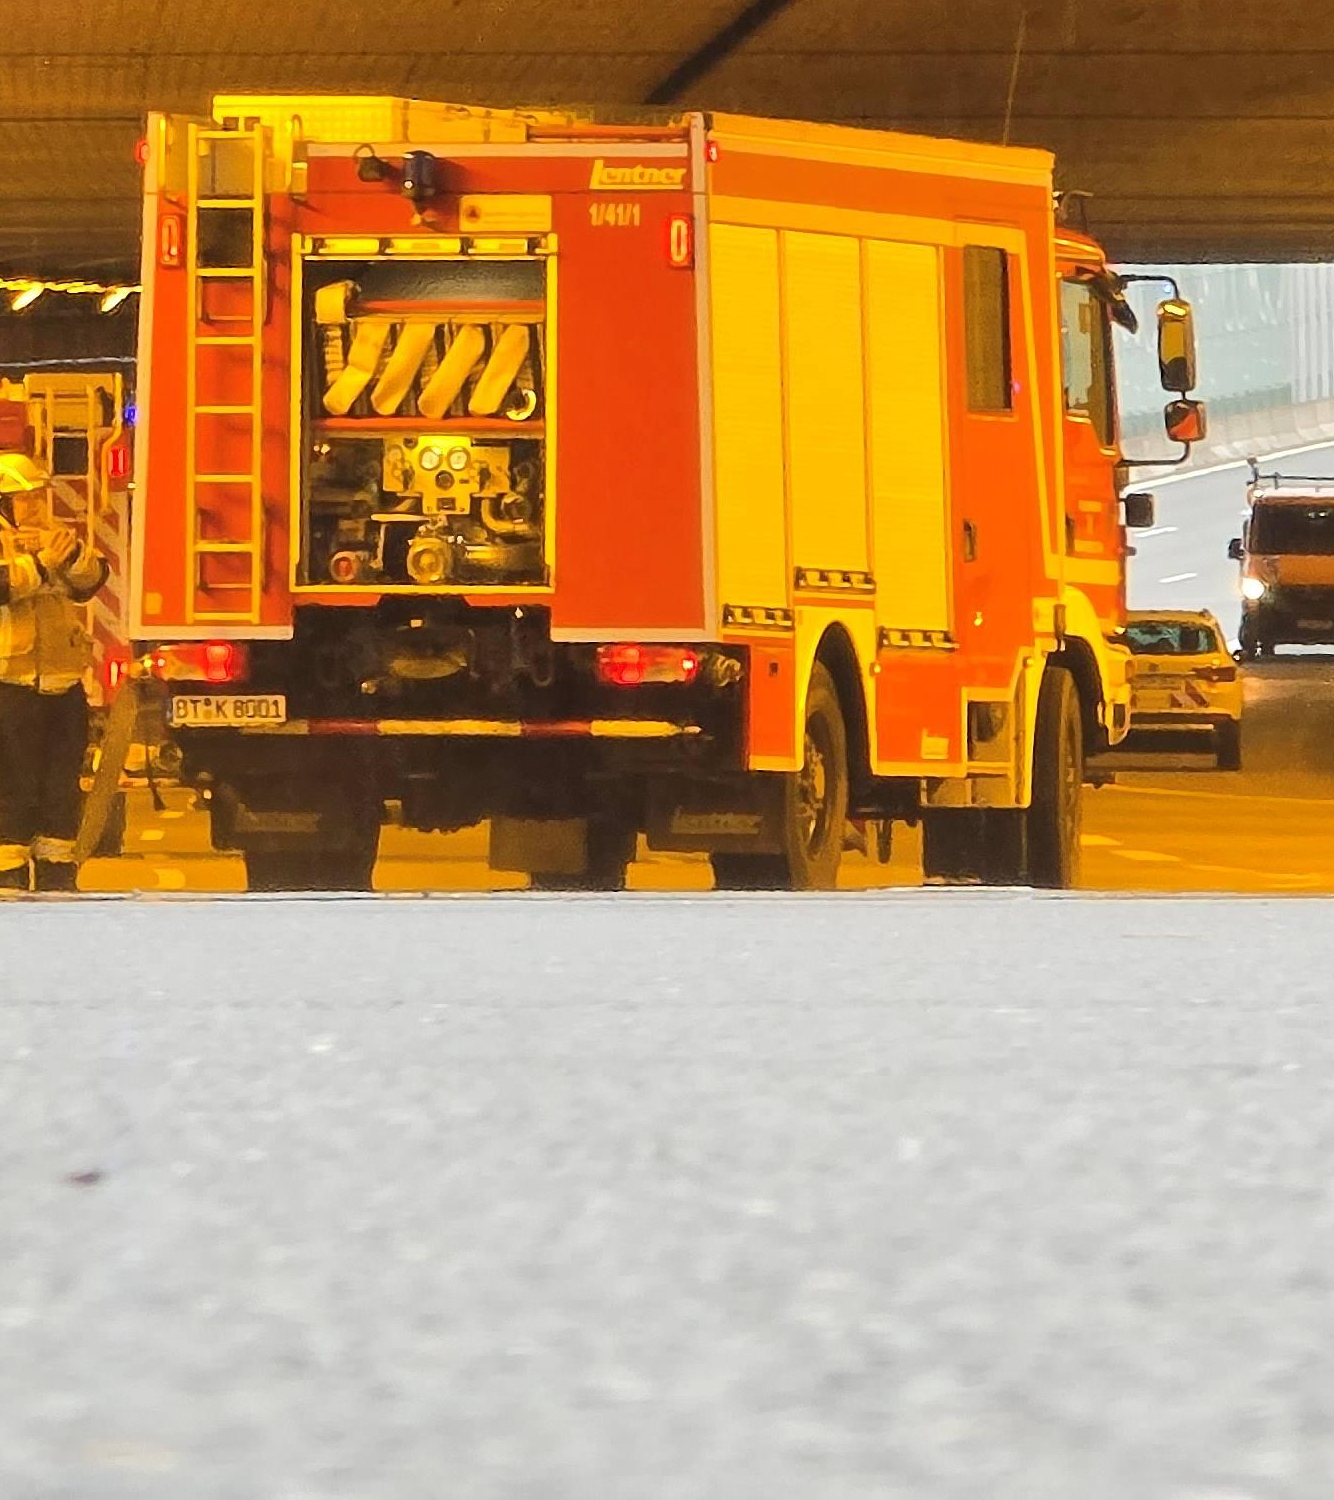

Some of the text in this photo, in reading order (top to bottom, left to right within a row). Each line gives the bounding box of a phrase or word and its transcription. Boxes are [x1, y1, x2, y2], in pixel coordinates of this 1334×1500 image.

[590, 159, 687, 190] Lentner
[589, 203, 640, 226] 1/41/1
[176, 699, 201, 719] BT
[216, 699, 228, 719] K
